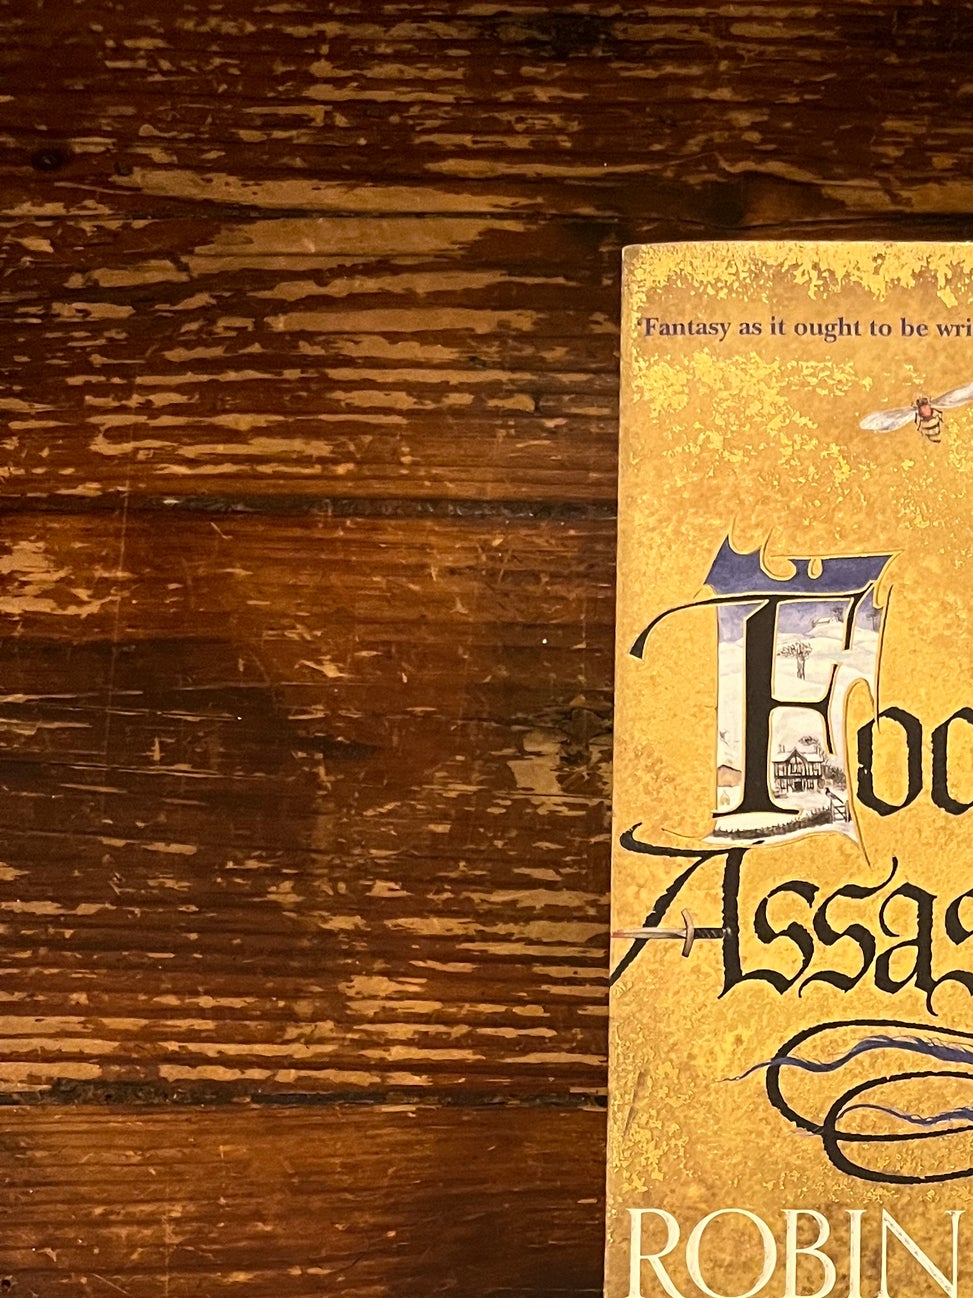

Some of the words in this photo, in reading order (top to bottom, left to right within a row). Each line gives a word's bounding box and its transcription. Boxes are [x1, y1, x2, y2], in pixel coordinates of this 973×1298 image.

[738, 322, 762, 336] as
[770, 316, 786, 336] it
[794, 316, 861, 342] ought
[870, 319, 892, 337] to
[901, 317, 929, 337] be
